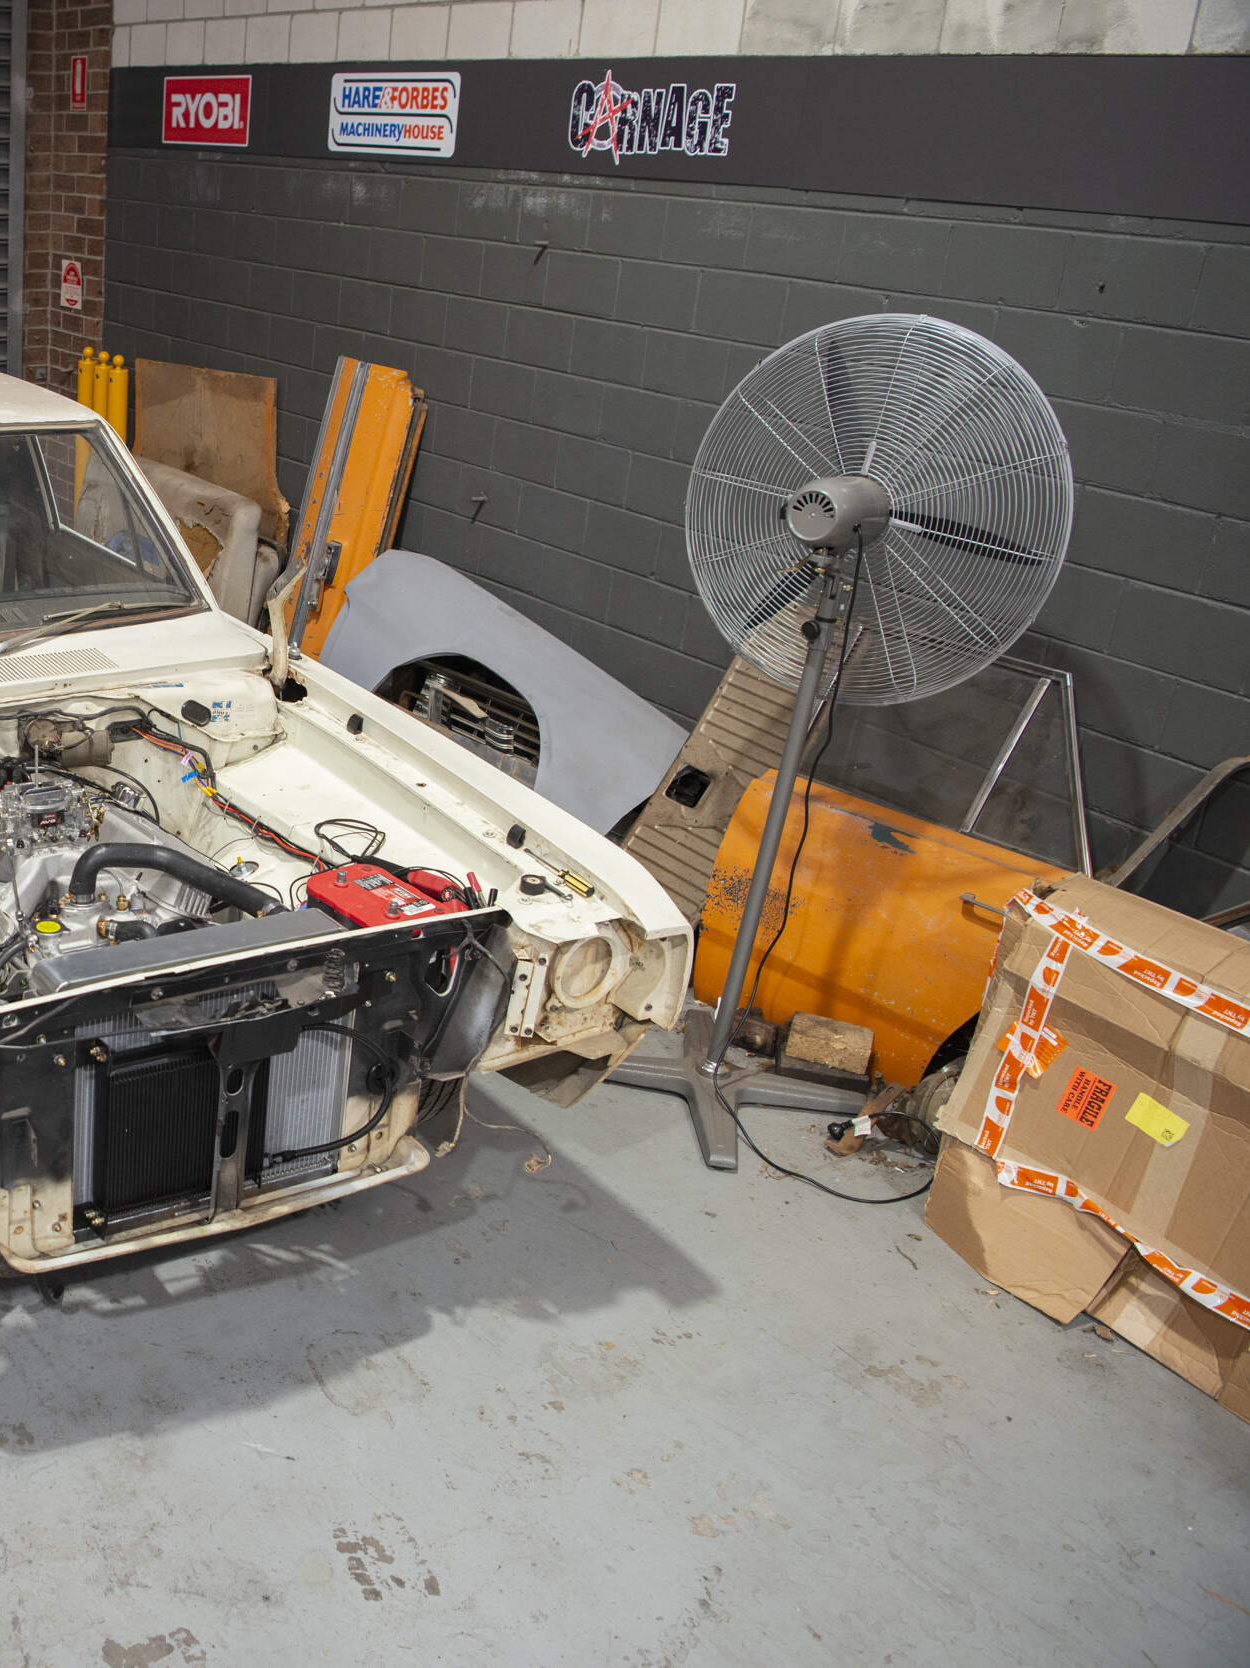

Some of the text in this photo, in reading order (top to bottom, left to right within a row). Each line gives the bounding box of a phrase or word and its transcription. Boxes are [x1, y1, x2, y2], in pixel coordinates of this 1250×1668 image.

[568, 69, 736, 166] CARNAGE
[1133, 969, 1162, 988] Repacked
[1143, 968, 1165, 983] by TNT
[1023, 998, 1035, 1023] Repacked
[1212, 1009, 1243, 1027] Repacked
[1223, 1008, 1246, 1023] by TNT
[1060, 1070, 1086, 1114] WITH CARE
[1071, 1078, 1091, 1111] HANDLE
[1079, 1079, 1112, 1128] FRAGILE
[1025, 1181, 1053, 1194] Repacked
